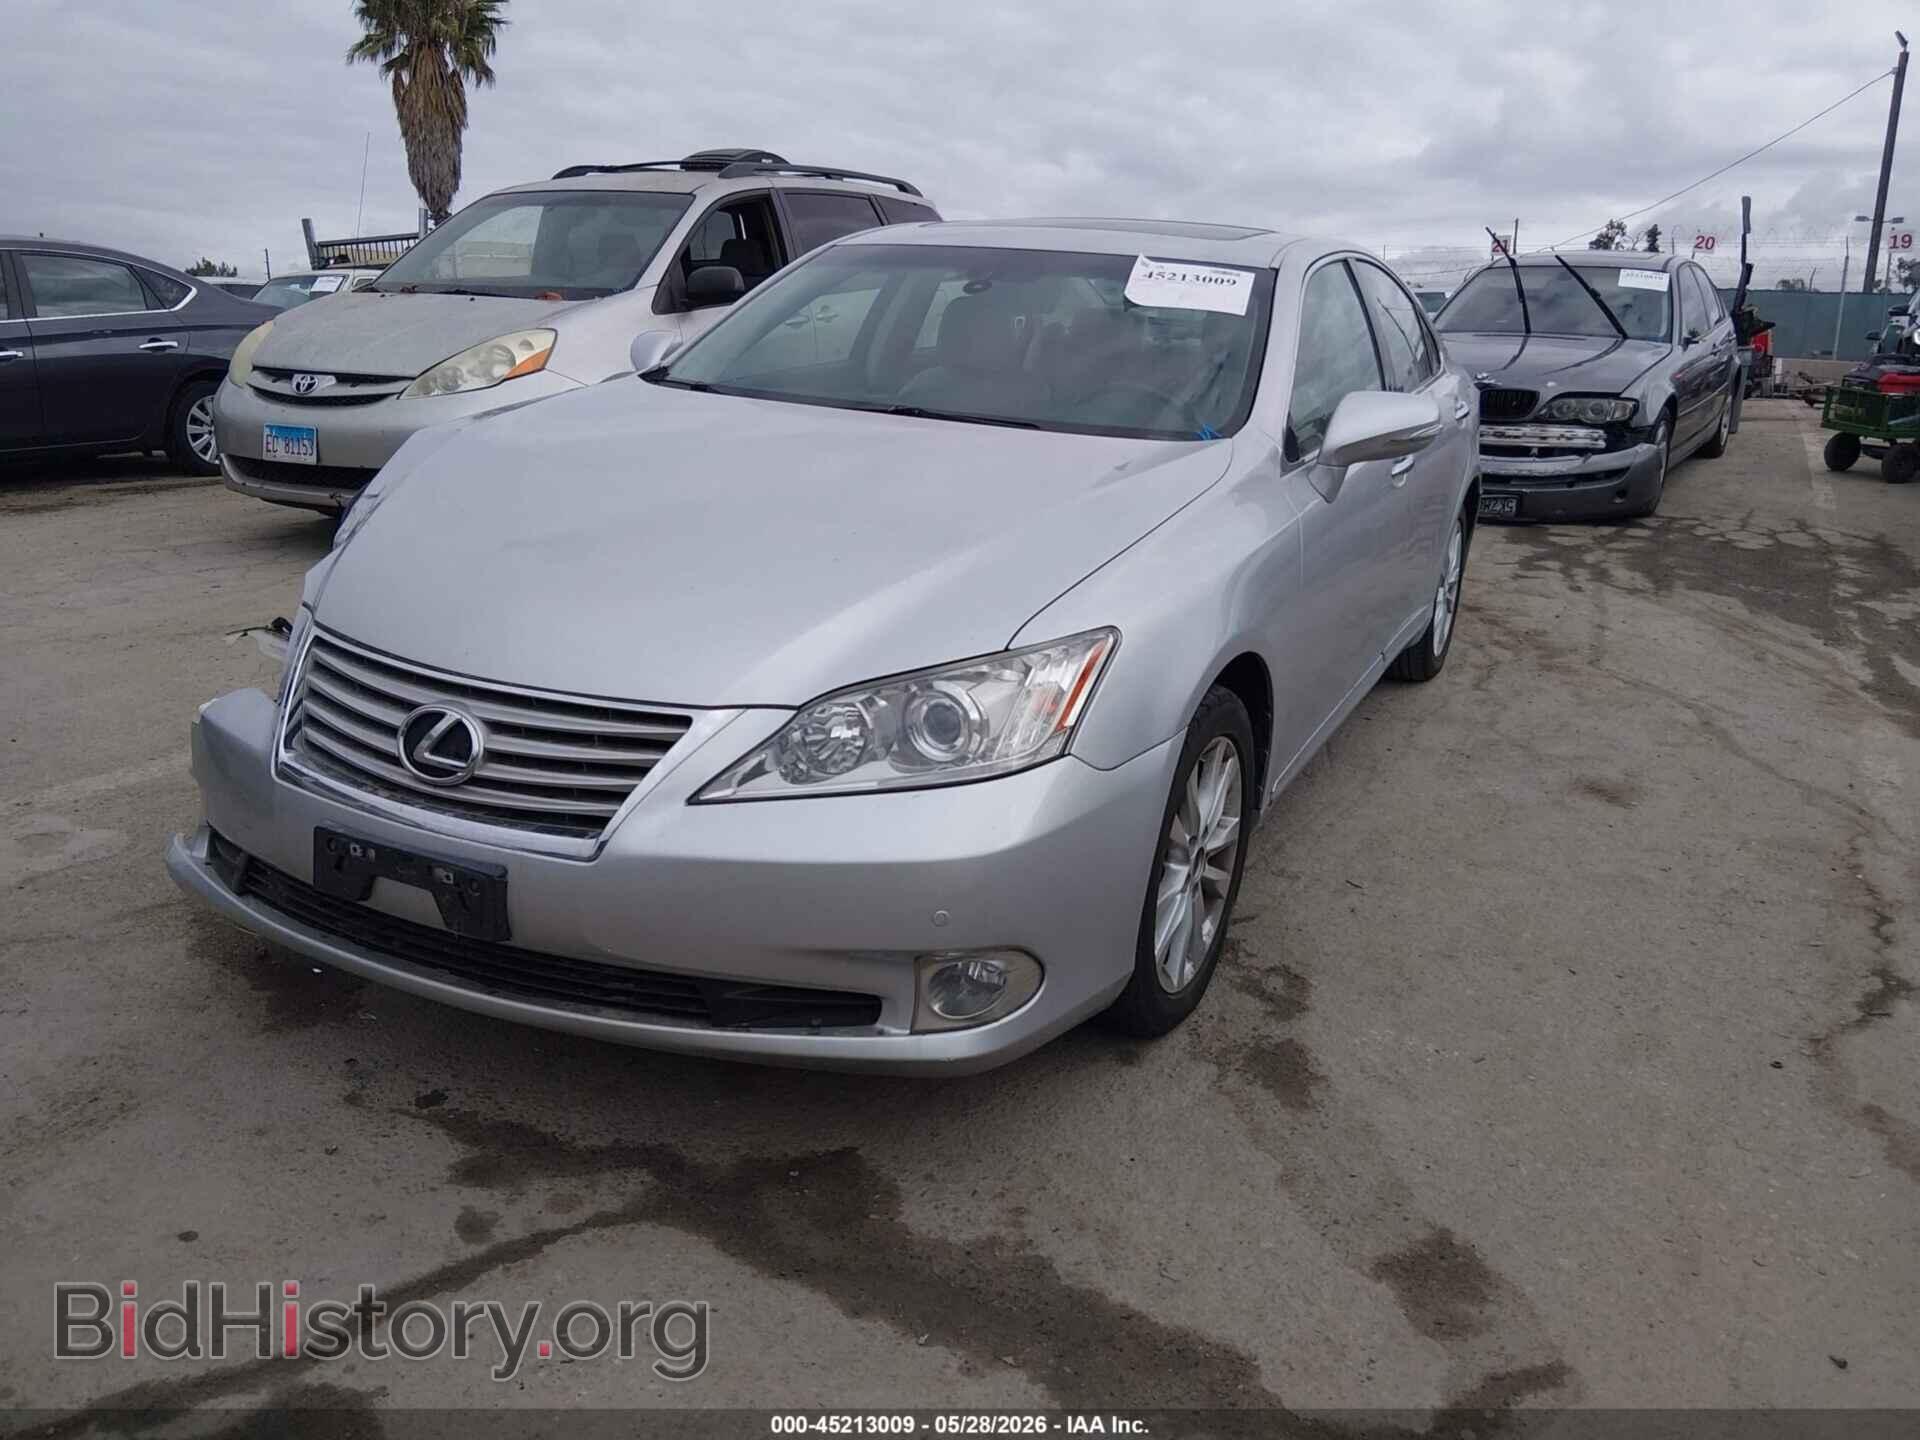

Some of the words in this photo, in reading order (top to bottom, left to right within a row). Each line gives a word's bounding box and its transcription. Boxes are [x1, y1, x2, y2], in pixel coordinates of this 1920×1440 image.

[1694, 234, 1715, 250] 20
[1889, 233, 1913, 249] 19
[1142, 270, 1237, 287] 45213009
